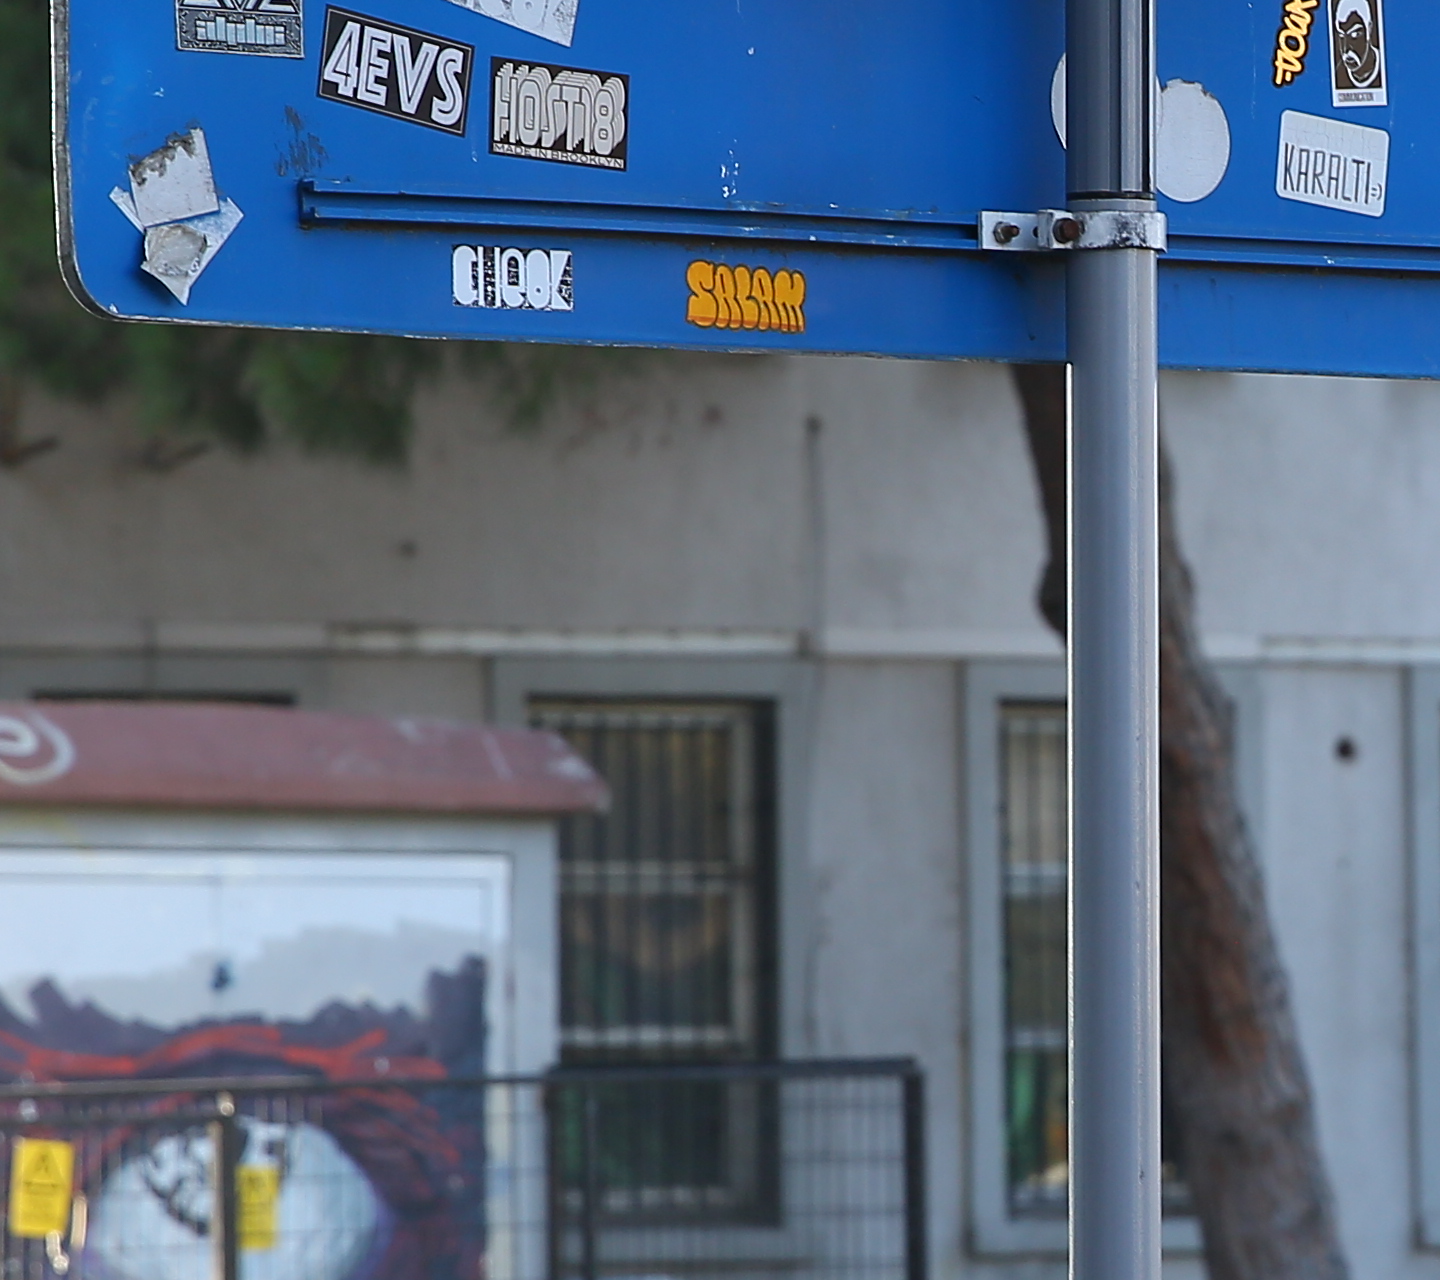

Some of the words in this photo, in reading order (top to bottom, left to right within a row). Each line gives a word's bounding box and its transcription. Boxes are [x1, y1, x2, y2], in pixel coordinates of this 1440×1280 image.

[323, 20, 464, 126] 4EVS
[494, 143, 531, 158] MADE
[532, 147, 549, 159] IN
[551, 151, 625, 169] BROOKLYN
